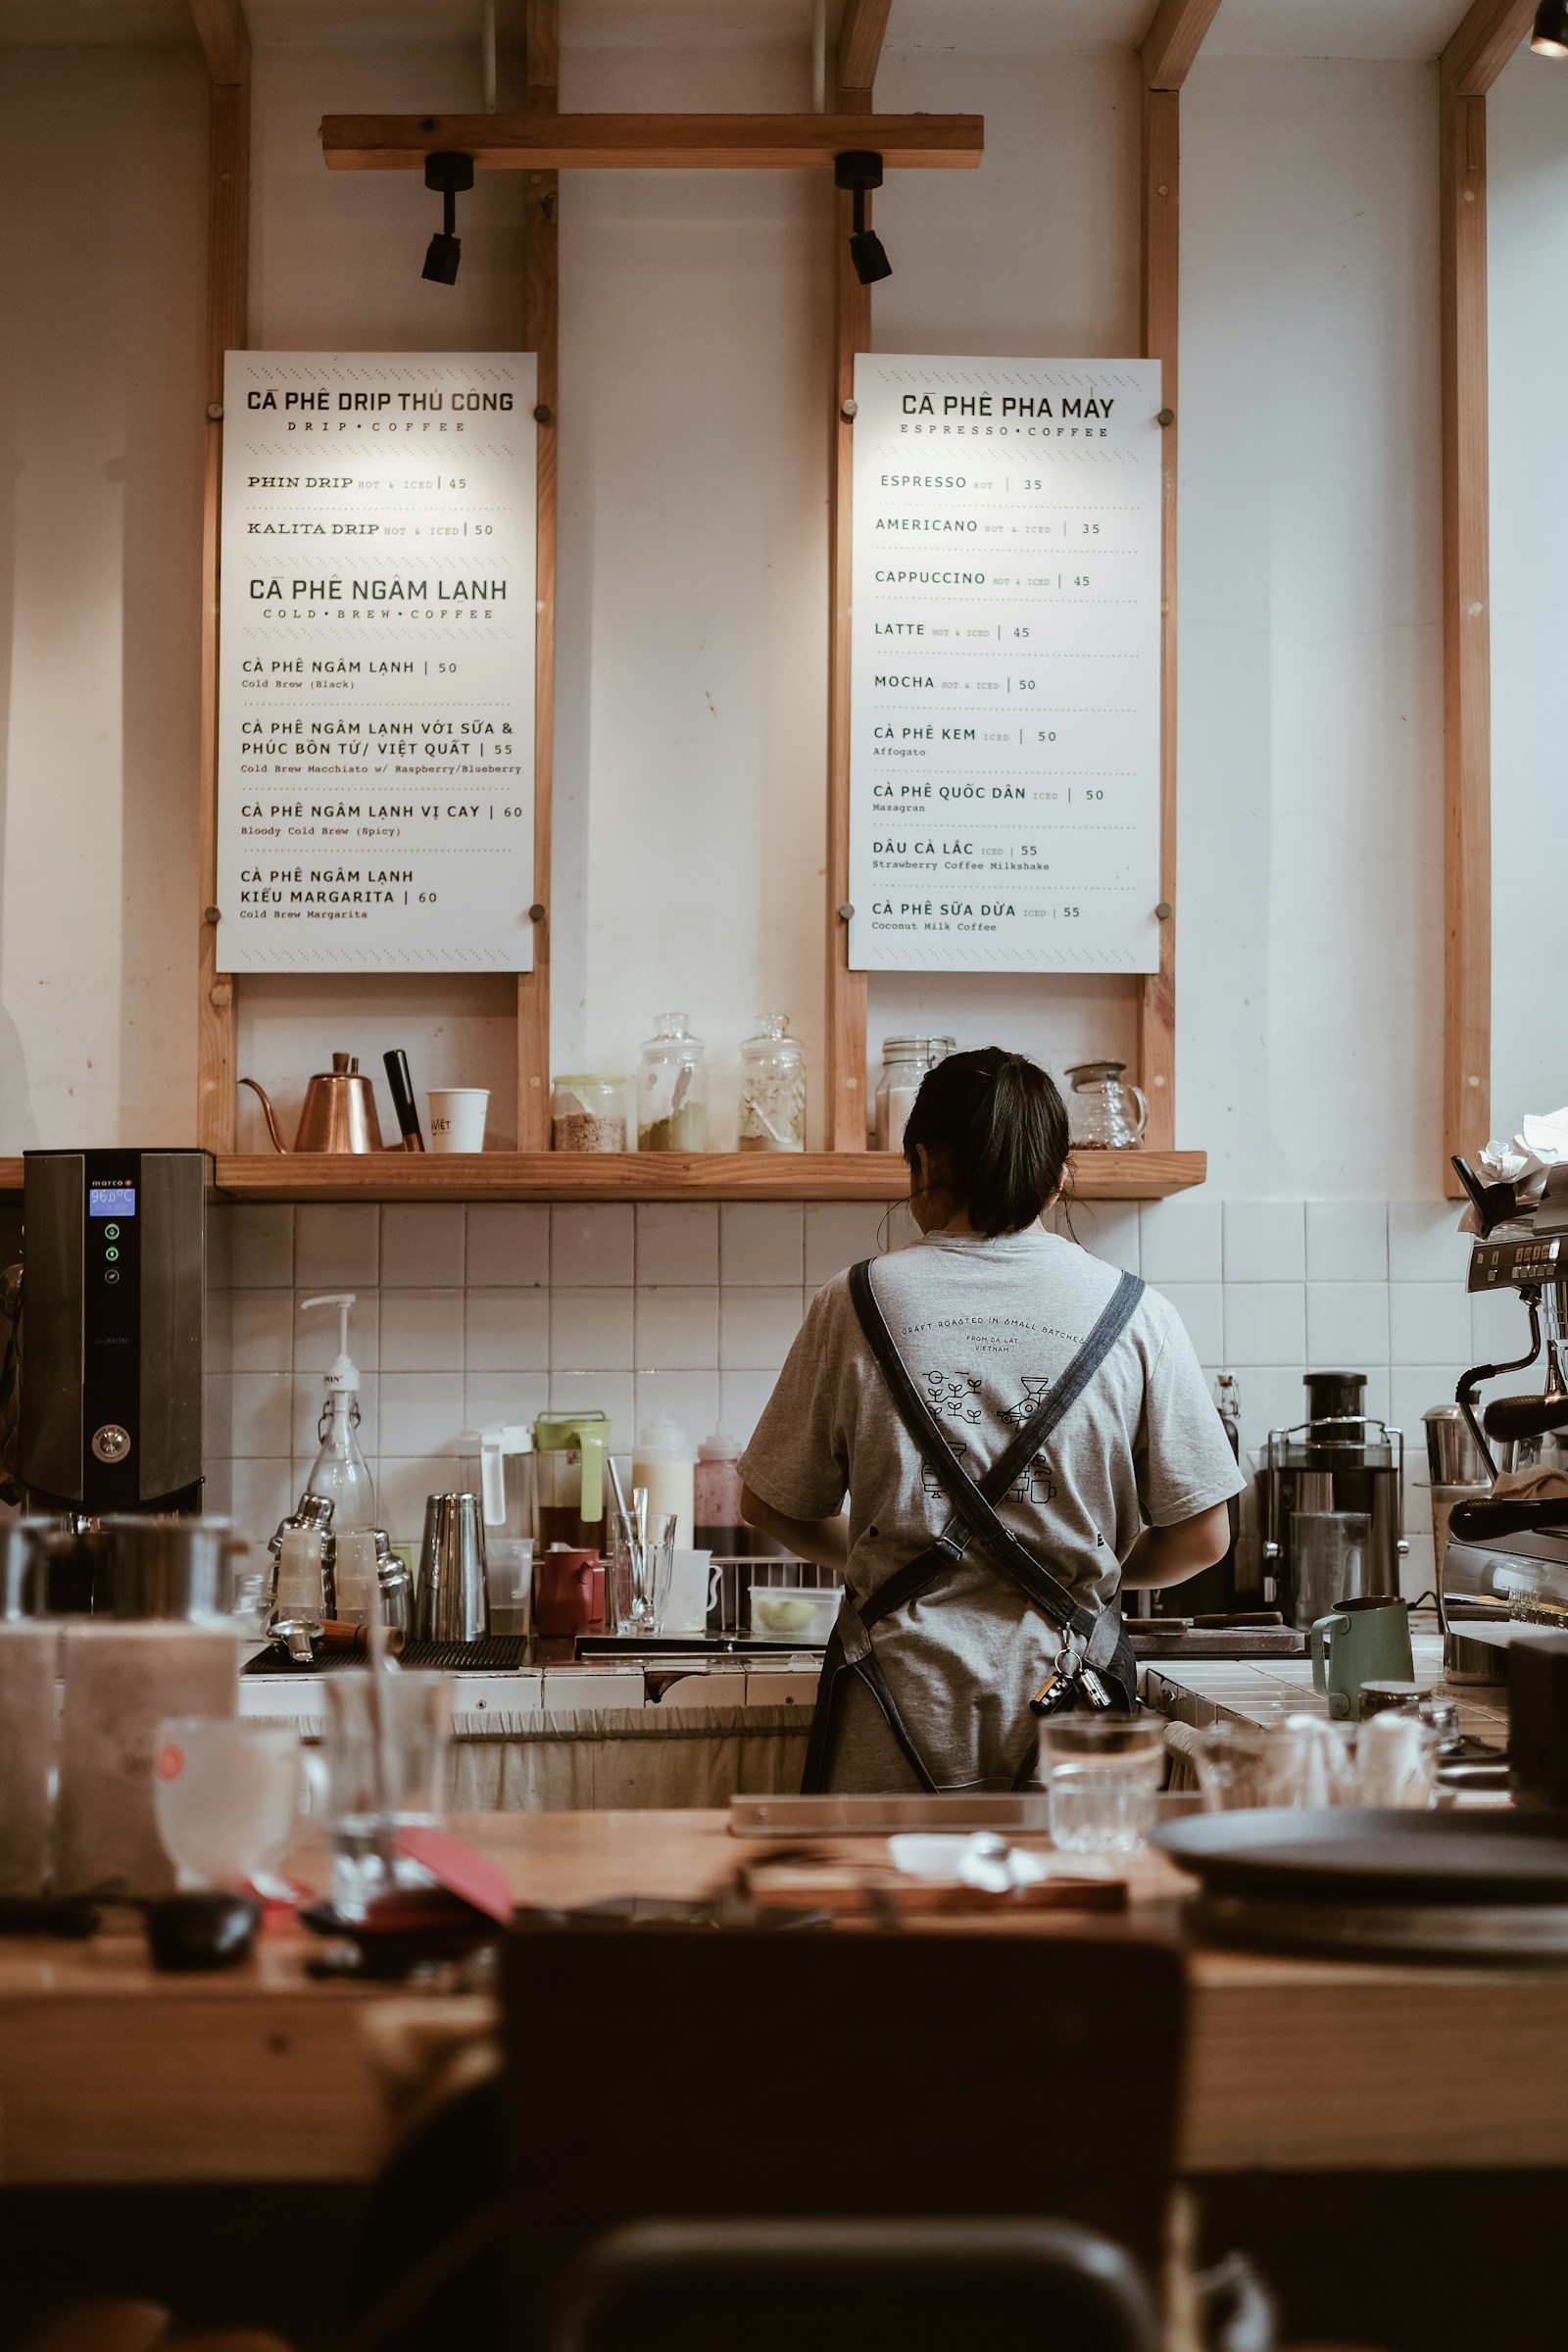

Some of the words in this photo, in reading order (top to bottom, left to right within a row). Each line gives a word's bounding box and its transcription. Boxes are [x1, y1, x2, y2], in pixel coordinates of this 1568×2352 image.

[285, 388, 329, 410] PHÊ
[339, 393, 391, 411] DRIP
[452, 388, 513, 411] CÔNG
[945, 391, 992, 416] PHÊ
[1003, 398, 1053, 417] PHA
[248, 477, 300, 487] PHIN
[306, 477, 353, 488] DRIP
[358, 480, 380, 489] HOT
[404, 480, 432, 489] ICED
[449, 479, 466, 488] 45
[881, 475, 965, 488] ESPRESSO
[1025, 480, 1041, 490] 35
[247, 523, 325, 534] KALITA
[331, 524, 379, 534] DRIP
[475, 525, 493, 535] 50
[875, 518, 977, 531] AMERICANO
[1083, 524, 1100, 533] 35
[875, 571, 985, 584] CAPPUCCINO
[1074, 576, 1089, 586] 45
[293, 574, 342, 600] PHÊ
[353, 574, 426, 600] NGÂM
[875, 623, 924, 635] LATTE
[1013, 628, 1029, 637] 45
[242, 658, 263, 672] CÀ
[272, 658, 303, 672] PHÊ
[313, 659, 360, 672] NGÂM
[369, 662, 413, 675] LẠNH
[439, 663, 457, 673] 50
[242, 679, 269, 688] Cold
[311, 680, 354, 690] (Black)
[875, 676, 934, 687] MOCHA
[1019, 680, 1035, 690] 50
[242, 719, 263, 734] CÀ
[271, 719, 303, 734] PHÊ
[312, 719, 360, 734] NGÂM
[369, 723, 413, 737] LẠNH
[903, 724, 933, 739] PHÊ
[943, 729, 974, 740] KEM
[1039, 732, 1055, 741] 50
[242, 739, 287, 754] PHÚC
[495, 745, 512, 755] 55
[873, 748, 925, 758] Affogato
[308, 764, 368, 773] Macchiato
[374, 764, 387, 773] w/
[902, 783, 931, 797] PHÊ
[993, 784, 1025, 799] DÂN
[1087, 791, 1103, 800] 50
[242, 802, 263, 816] CÀ
[271, 803, 302, 817] PHÊ
[312, 803, 360, 817] NGÂM
[369, 807, 413, 820] LẠNH
[447, 806, 478, 816] CAY
[505, 808, 521, 817] 60
[873, 804, 925, 813] Mazagran
[241, 826, 280, 837] Bloody
[288, 826, 315, 835] Cold
[357, 827, 400, 837] (Spicy)
[1021, 846, 1037, 856] 55
[872, 860, 938, 870] Strawberry
[241, 867, 262, 882] CÀ
[270, 867, 302, 882] PHÊ
[311, 867, 359, 882] NGÂM
[368, 871, 412, 885] LẠNH
[291, 892, 393, 903] MARGARITA
[418, 893, 436, 903] 60
[307, 910, 367, 920] Margarita
[902, 901, 932, 915] PHÊ
[1064, 907, 1079, 917] 55
[902, 1323, 931, 1335] CRAFT
[939, 1318, 983, 1327] ROASTED
[1004, 1318, 1037, 1331] SMALL
[1042, 1326, 1085, 1345] BATCHES
